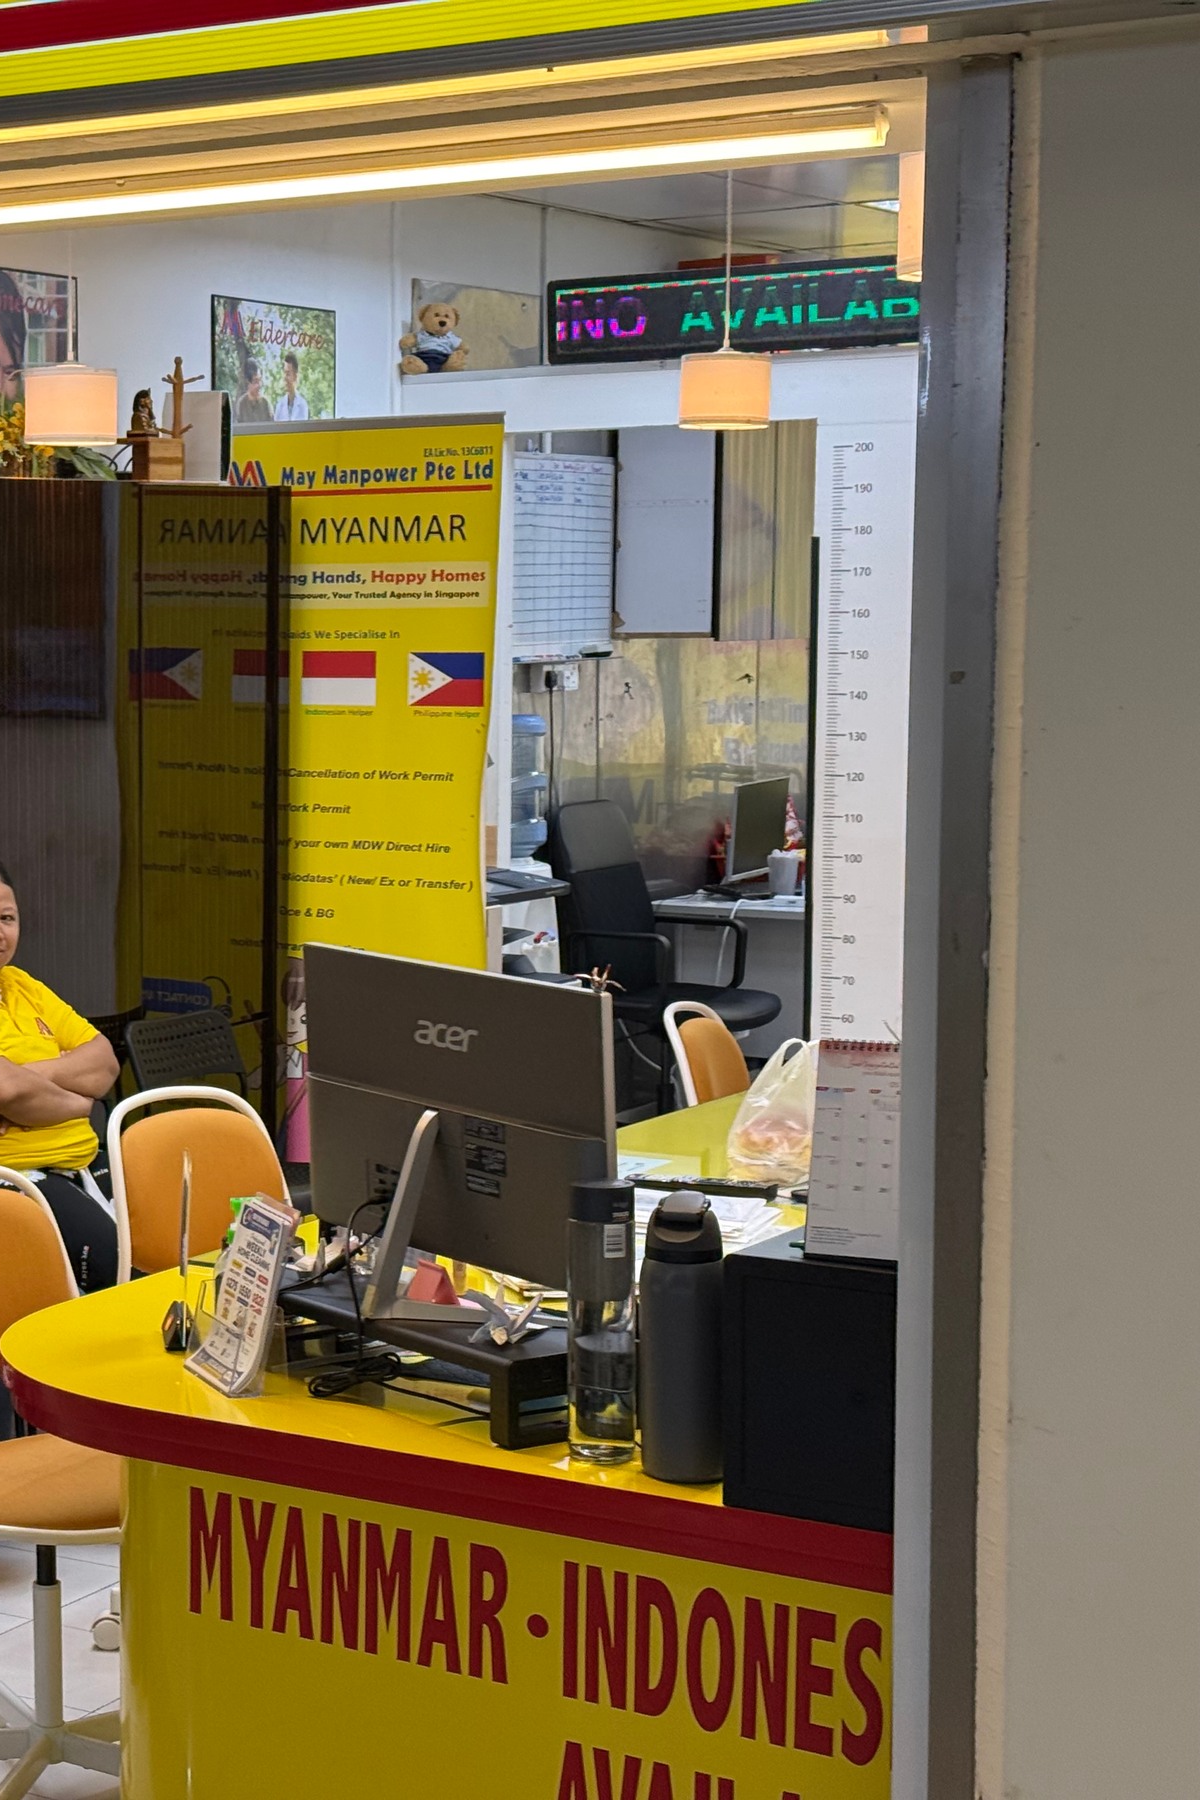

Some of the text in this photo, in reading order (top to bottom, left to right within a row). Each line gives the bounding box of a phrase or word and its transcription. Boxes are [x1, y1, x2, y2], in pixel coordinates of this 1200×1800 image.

[248, 319, 325, 350] Eldercare
[854, 441, 874, 452] 200
[281, 459, 493, 489] May Manpower Pte Ltd
[854, 482, 872, 493] 190
[300, 513, 467, 544] MYANMAR
[853, 525, 872, 535] 180
[312, 570, 366, 584] Hands,
[371, 569, 427, 585] Happy
[431, 568, 486, 582] Homes
[852, 567, 871, 577] 170
[332, 592, 353, 600] Your
[355, 591, 387, 599] Trusted
[389, 590, 422, 600] Agency
[424, 590, 433, 598] in
[434, 590, 480, 600] Singapore
[851, 608, 870, 618] 160
[314, 630, 332, 639] We
[334, 630, 387, 640] Specialise
[850, 650, 869, 660] 150
[849, 690, 867, 701] 140
[848, 731, 867, 742] 130
[363, 770, 377, 779] of
[379, 770, 410, 781] Work
[413, 771, 454, 782] Permit
[845, 772, 865, 782] 120
[312, 803, 351, 814] Permit
[844, 813, 863, 823] 110
[294, 840, 321, 849] your
[324, 841, 349, 849] own
[351, 840, 384, 851] MDW
[386, 841, 422, 852] Direct
[425, 843, 451, 853] Hire
[843, 853, 862, 863] 100
[379, 876, 396, 886] Ex
[398, 879, 412, 887] or
[415, 878, 467, 890] Transfer
[843, 894, 856, 904] 90
[316, 908, 335, 918] BG
[842, 934, 855, 944] 80
[842, 975, 855, 985] 70
[841, 1014, 854, 1024] 60
[413, 1019, 480, 1052] acer
[189, 1486, 892, 1767] MYANMAR INDONES
